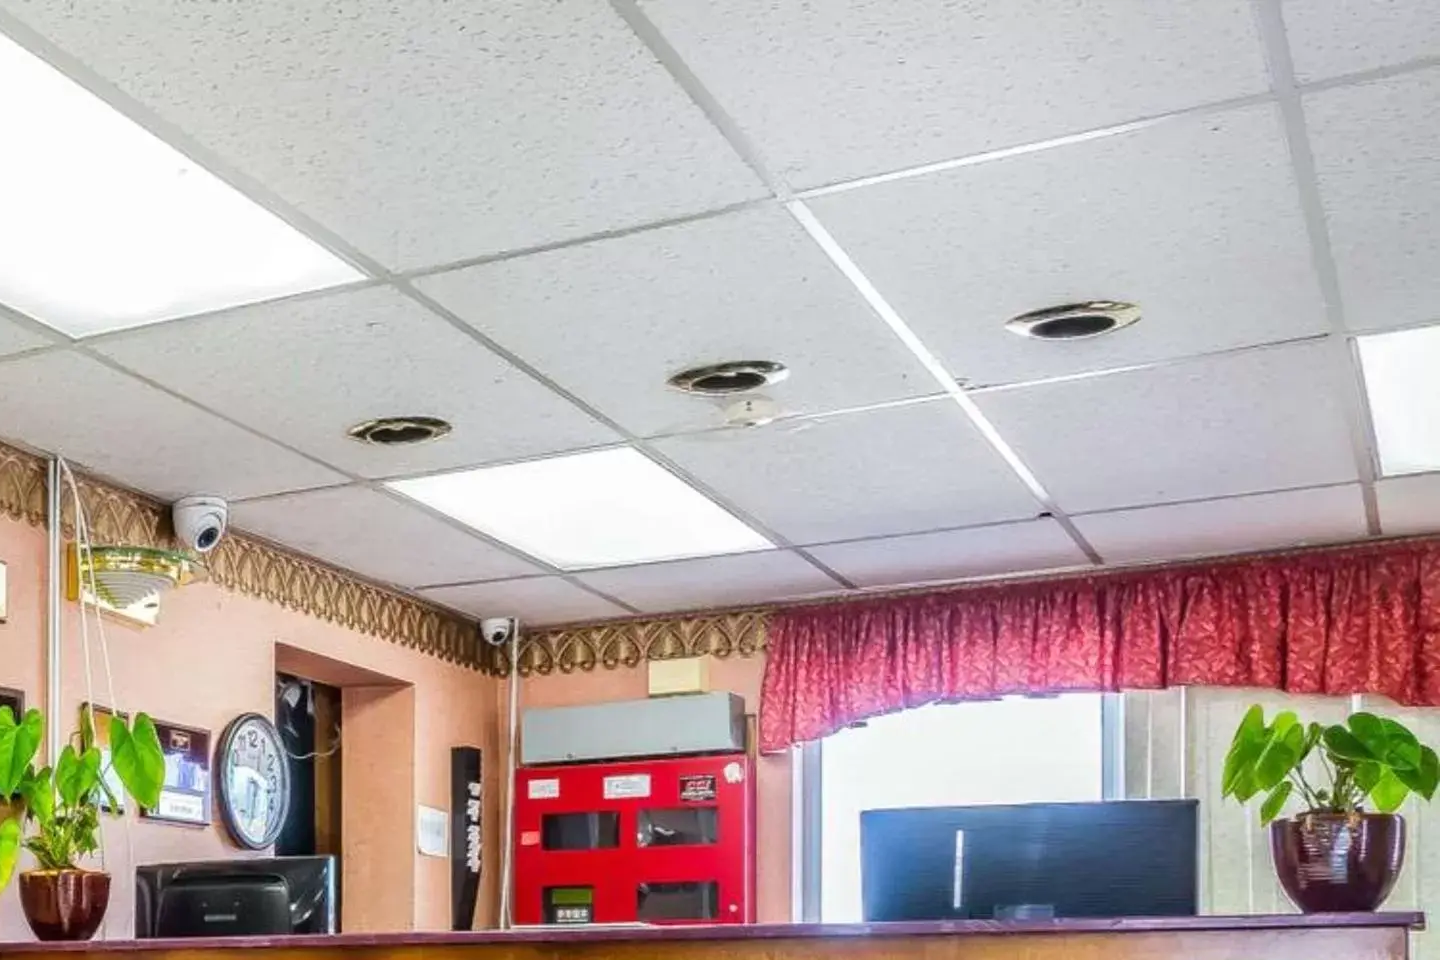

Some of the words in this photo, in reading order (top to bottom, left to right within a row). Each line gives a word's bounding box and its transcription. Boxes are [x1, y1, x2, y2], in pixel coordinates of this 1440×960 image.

[247, 730, 258, 748] 12
[267, 755, 276, 772] 2
[267, 776, 277, 794] 3
